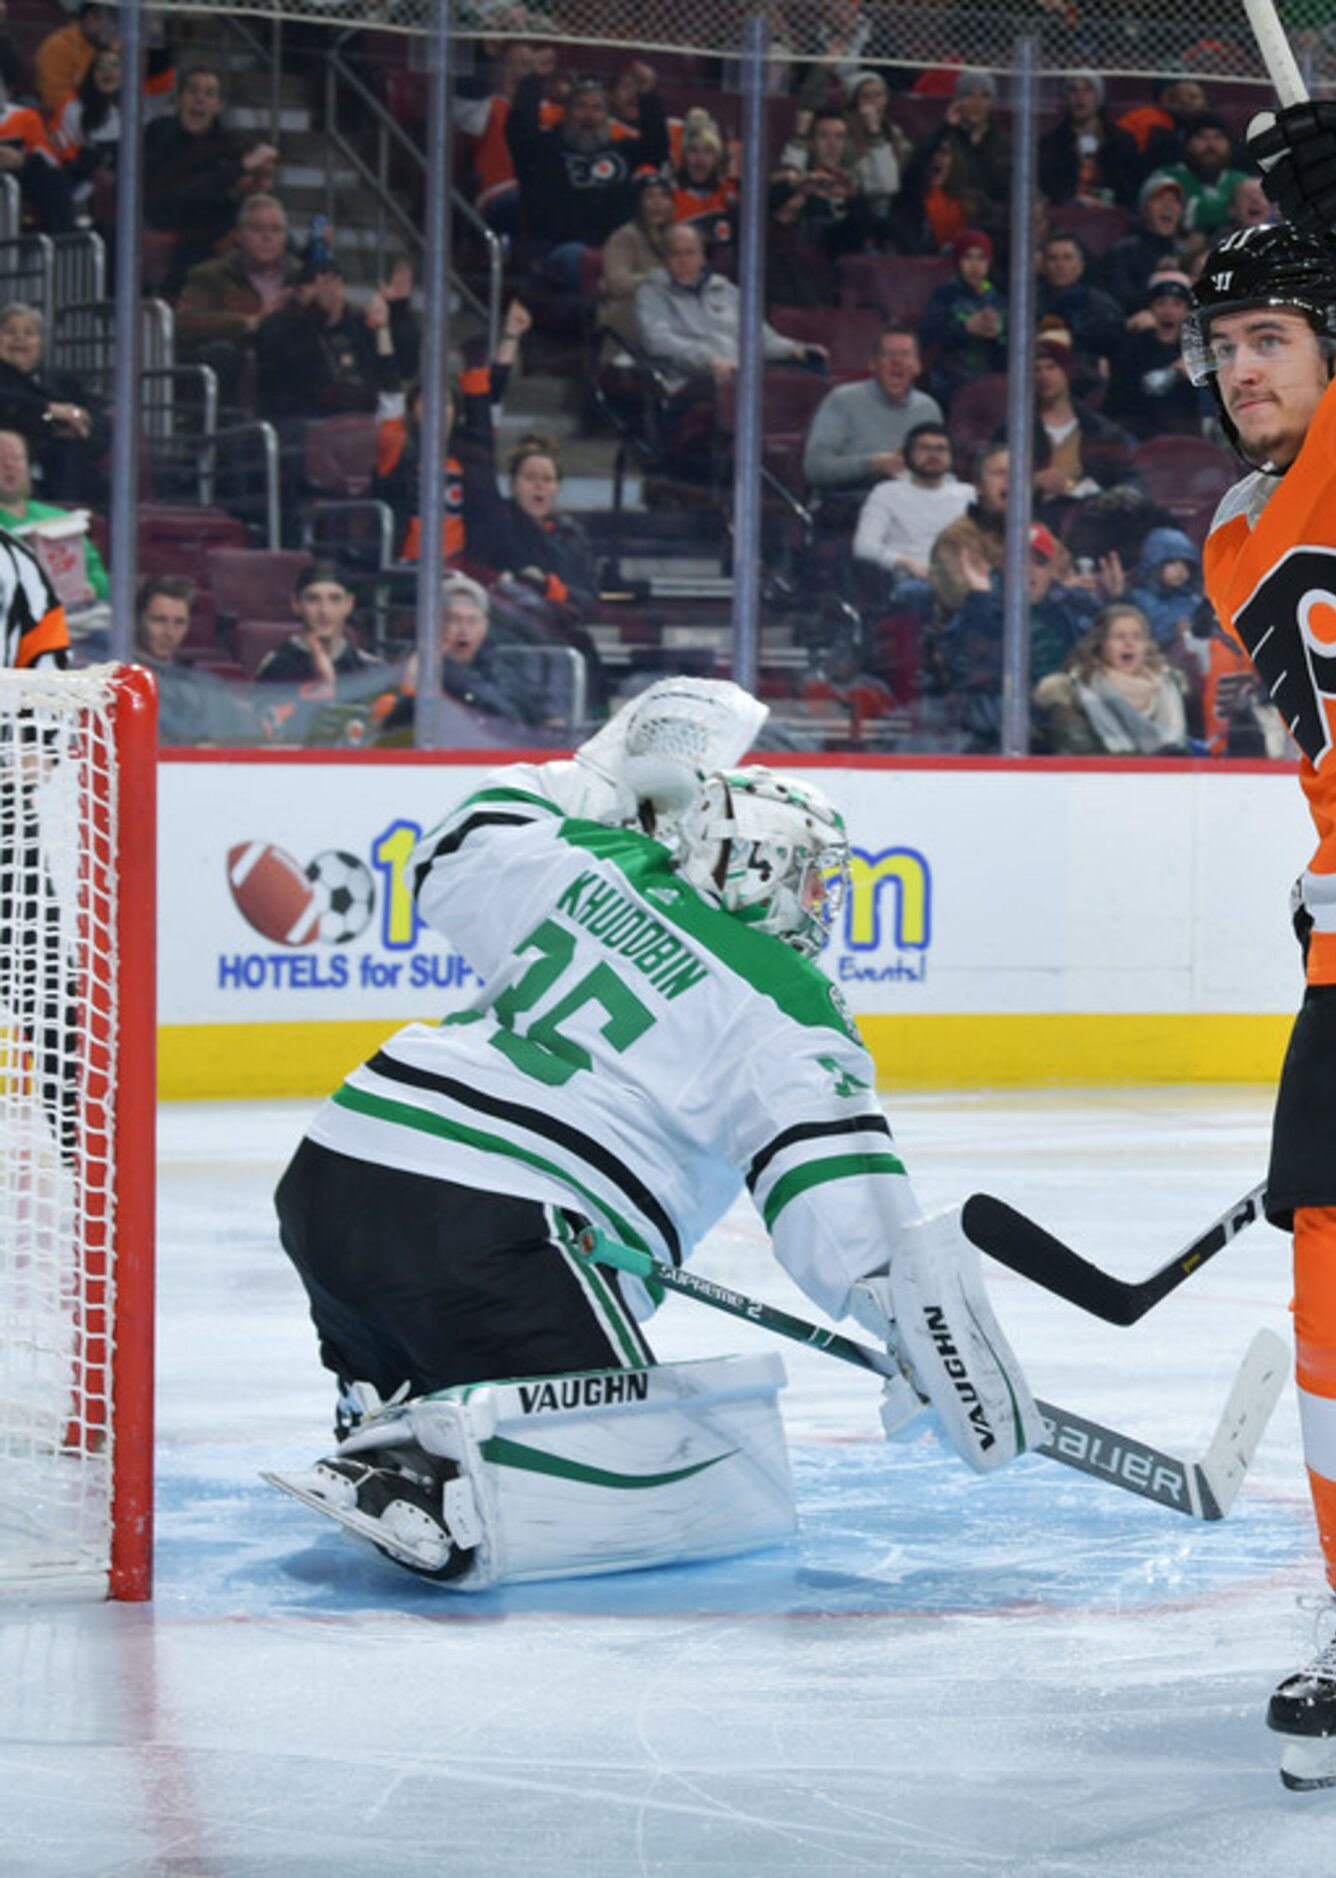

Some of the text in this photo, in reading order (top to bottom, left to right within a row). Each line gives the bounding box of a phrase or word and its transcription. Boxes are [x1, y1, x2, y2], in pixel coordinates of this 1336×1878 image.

[218, 954, 349, 988] HOTELS
[360, 954, 402, 988] for
[838, 954, 926, 983] Events!
[556, 869, 709, 1001] KHUDOBIN
[518, 1371, 648, 1415] VAUGHN
[923, 1305, 996, 1452] VAUGHN
